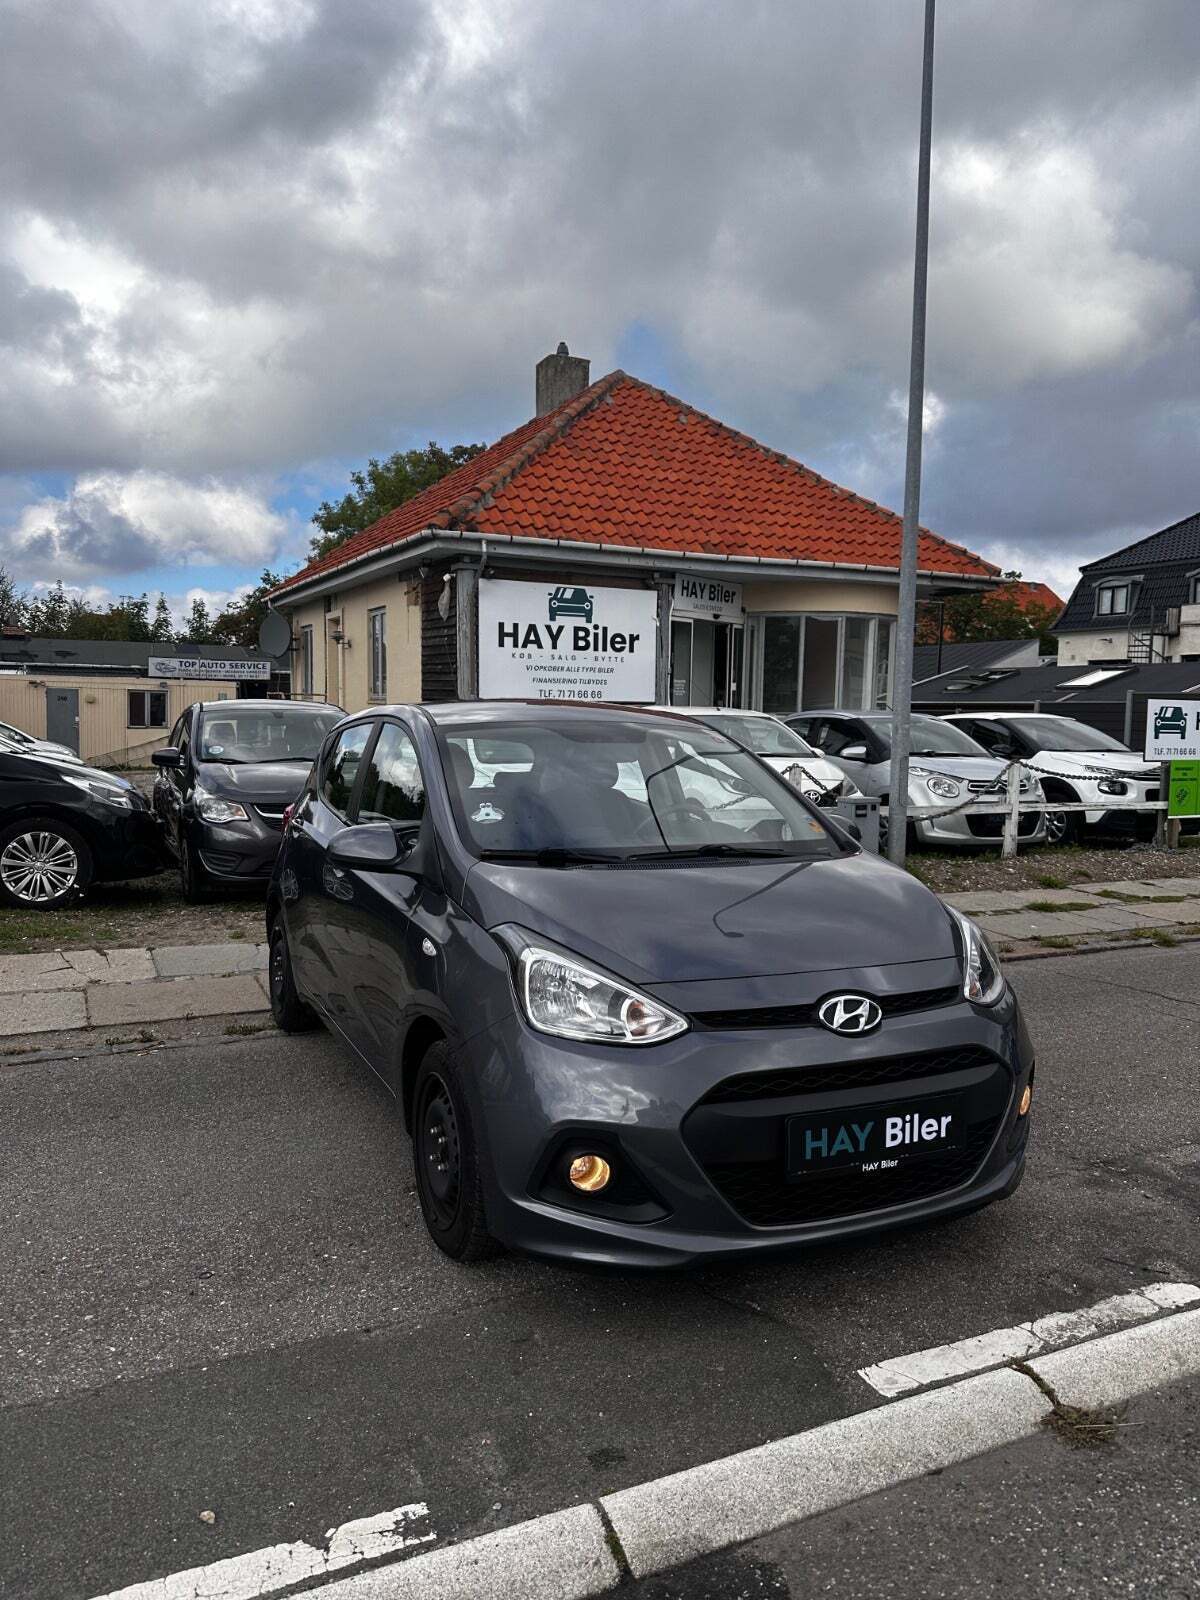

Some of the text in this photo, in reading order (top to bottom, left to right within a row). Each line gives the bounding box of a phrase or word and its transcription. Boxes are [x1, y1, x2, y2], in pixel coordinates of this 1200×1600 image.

[681, 579, 736, 603] HAY Biler
[498, 621, 639, 653] HAY Biler
[594, 655, 625, 663] BYTTE
[179, 660, 267, 670] TOP AUTO SERVICE
[579, 678, 607, 686] TILBYDES
[539, 689, 602, 699] TLF. 71 71 66 66
[1154, 747, 1165, 755] TLF.
[804, 1113, 952, 1160] HAY Biler
[862, 1159, 899, 1172] HAY Biler
